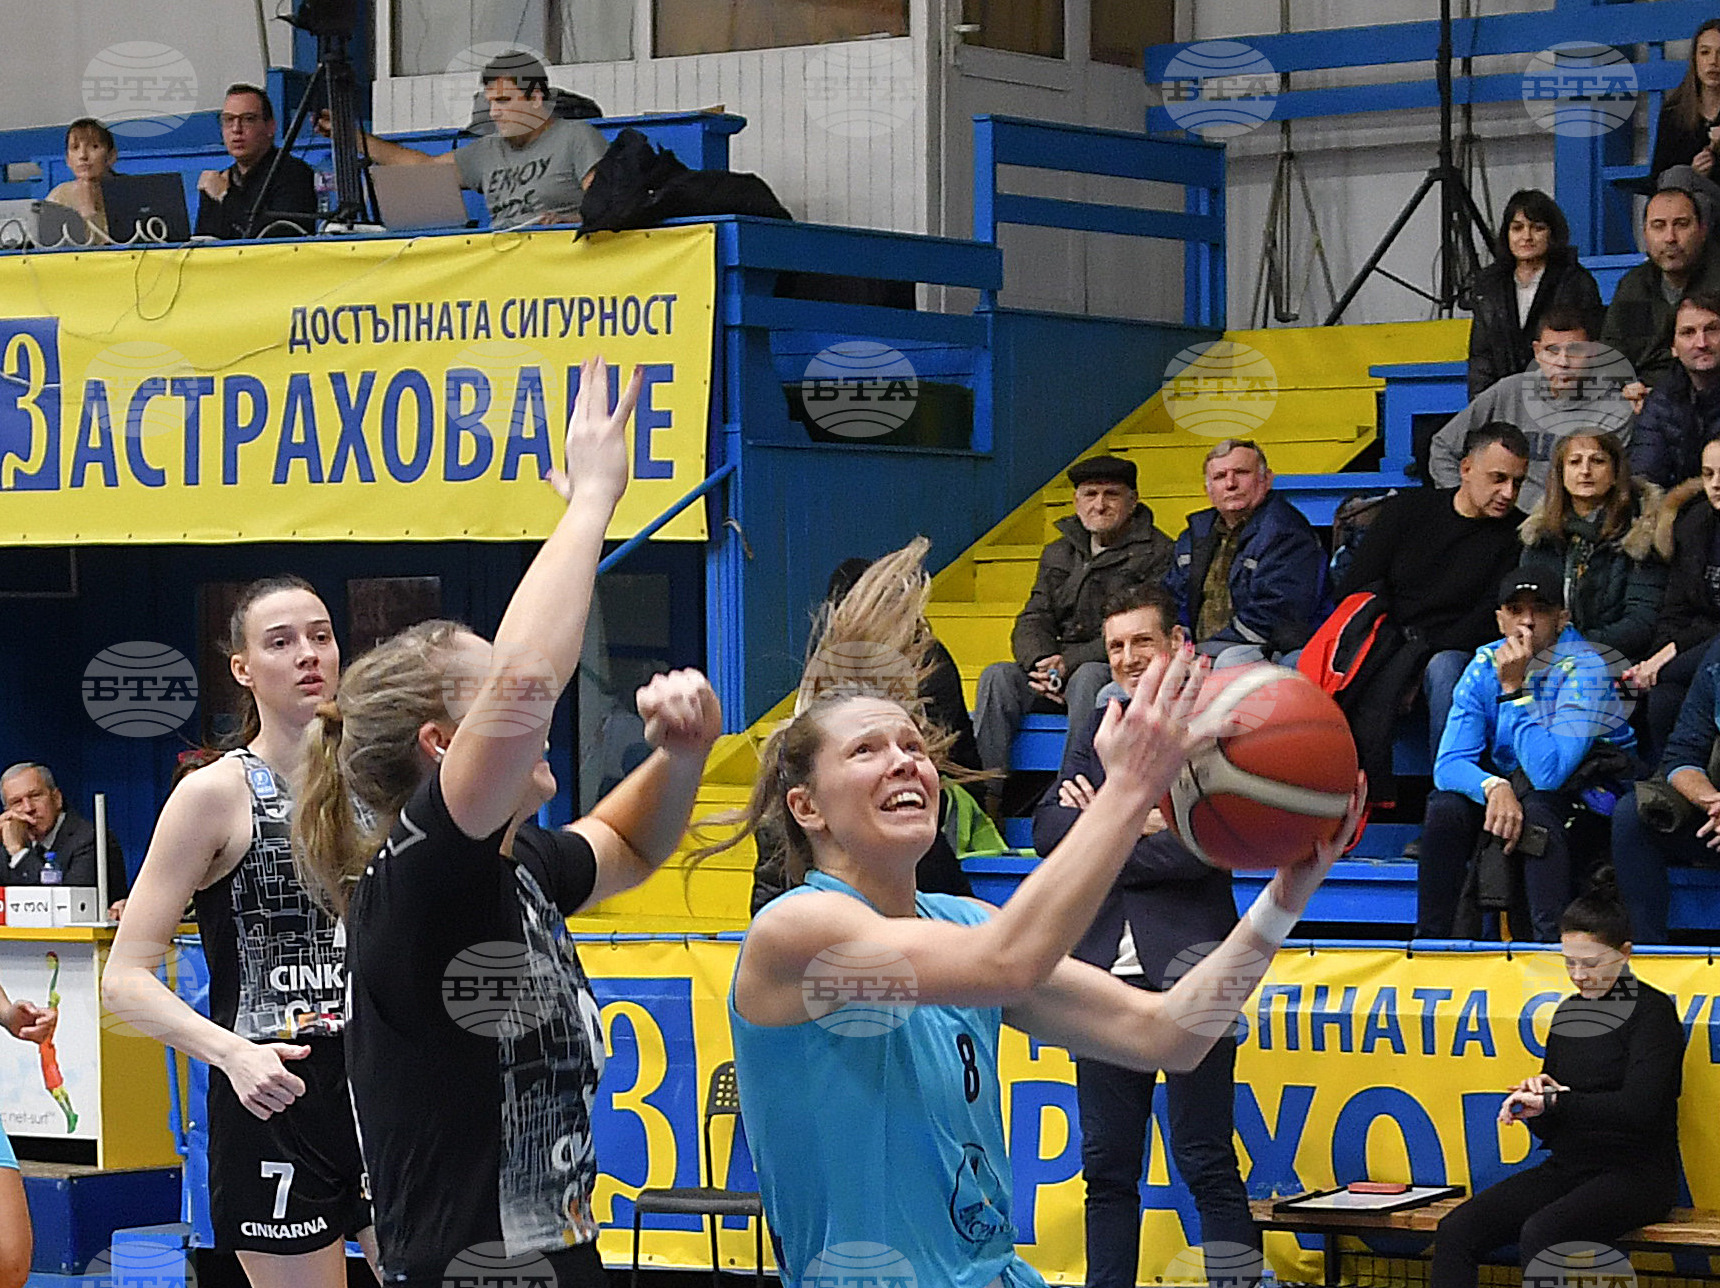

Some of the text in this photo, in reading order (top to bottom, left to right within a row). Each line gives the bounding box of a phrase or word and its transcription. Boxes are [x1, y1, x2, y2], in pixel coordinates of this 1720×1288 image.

[489, 154, 553, 193] ENJOY
[289, 294, 678, 354] ДОСТЪПНАТА СИГУРНОСТ
[269, 963, 344, 992] CINK
[956, 1033, 981, 1104] 8
[260, 1160, 295, 1219] 7
[240, 1216, 328, 1239] CINKARNA
